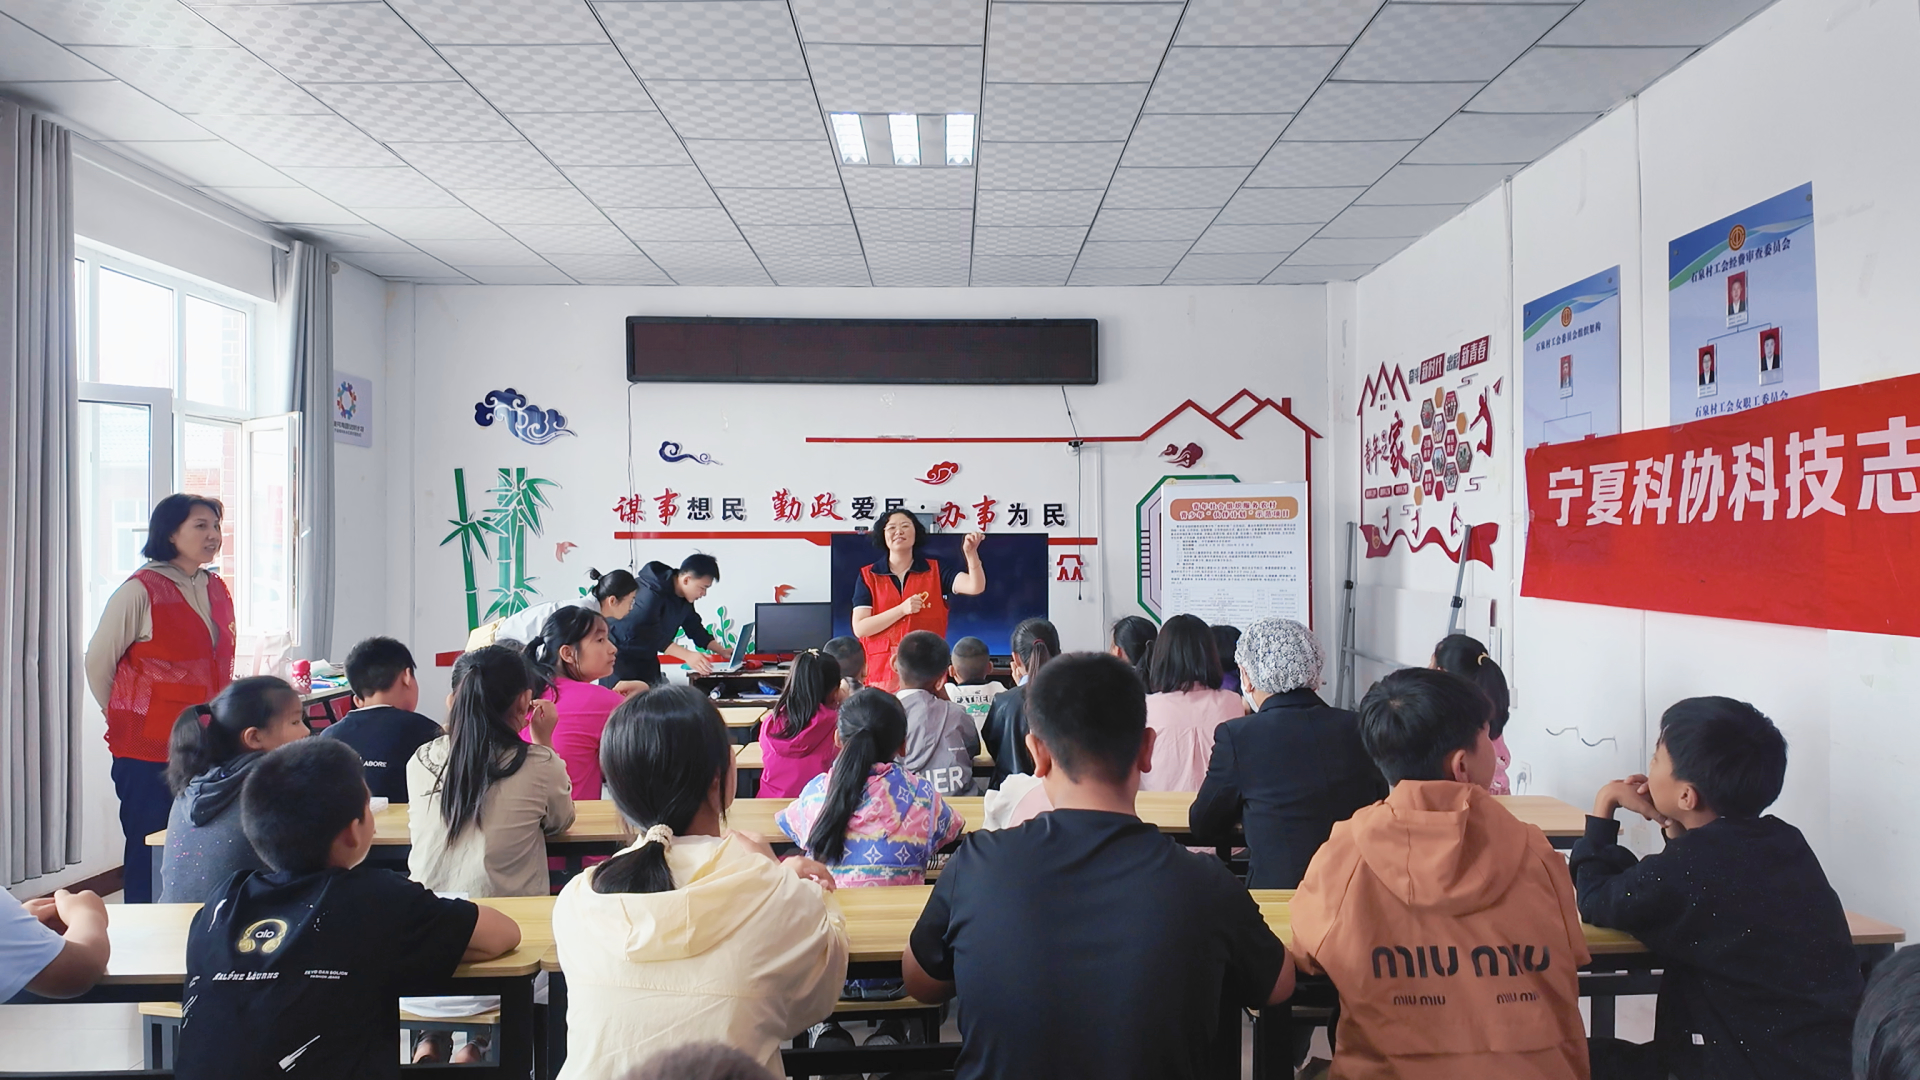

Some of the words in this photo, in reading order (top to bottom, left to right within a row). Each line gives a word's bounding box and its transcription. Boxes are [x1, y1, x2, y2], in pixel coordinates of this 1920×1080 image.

[1691, 237, 1791, 283] 石泉村工会经费审查委员会
[1548, 415, 1920, 527] 宁夏科协科技志
[612, 488, 744, 525] 谋事想民
[936, 495, 1066, 531] 办事为民
